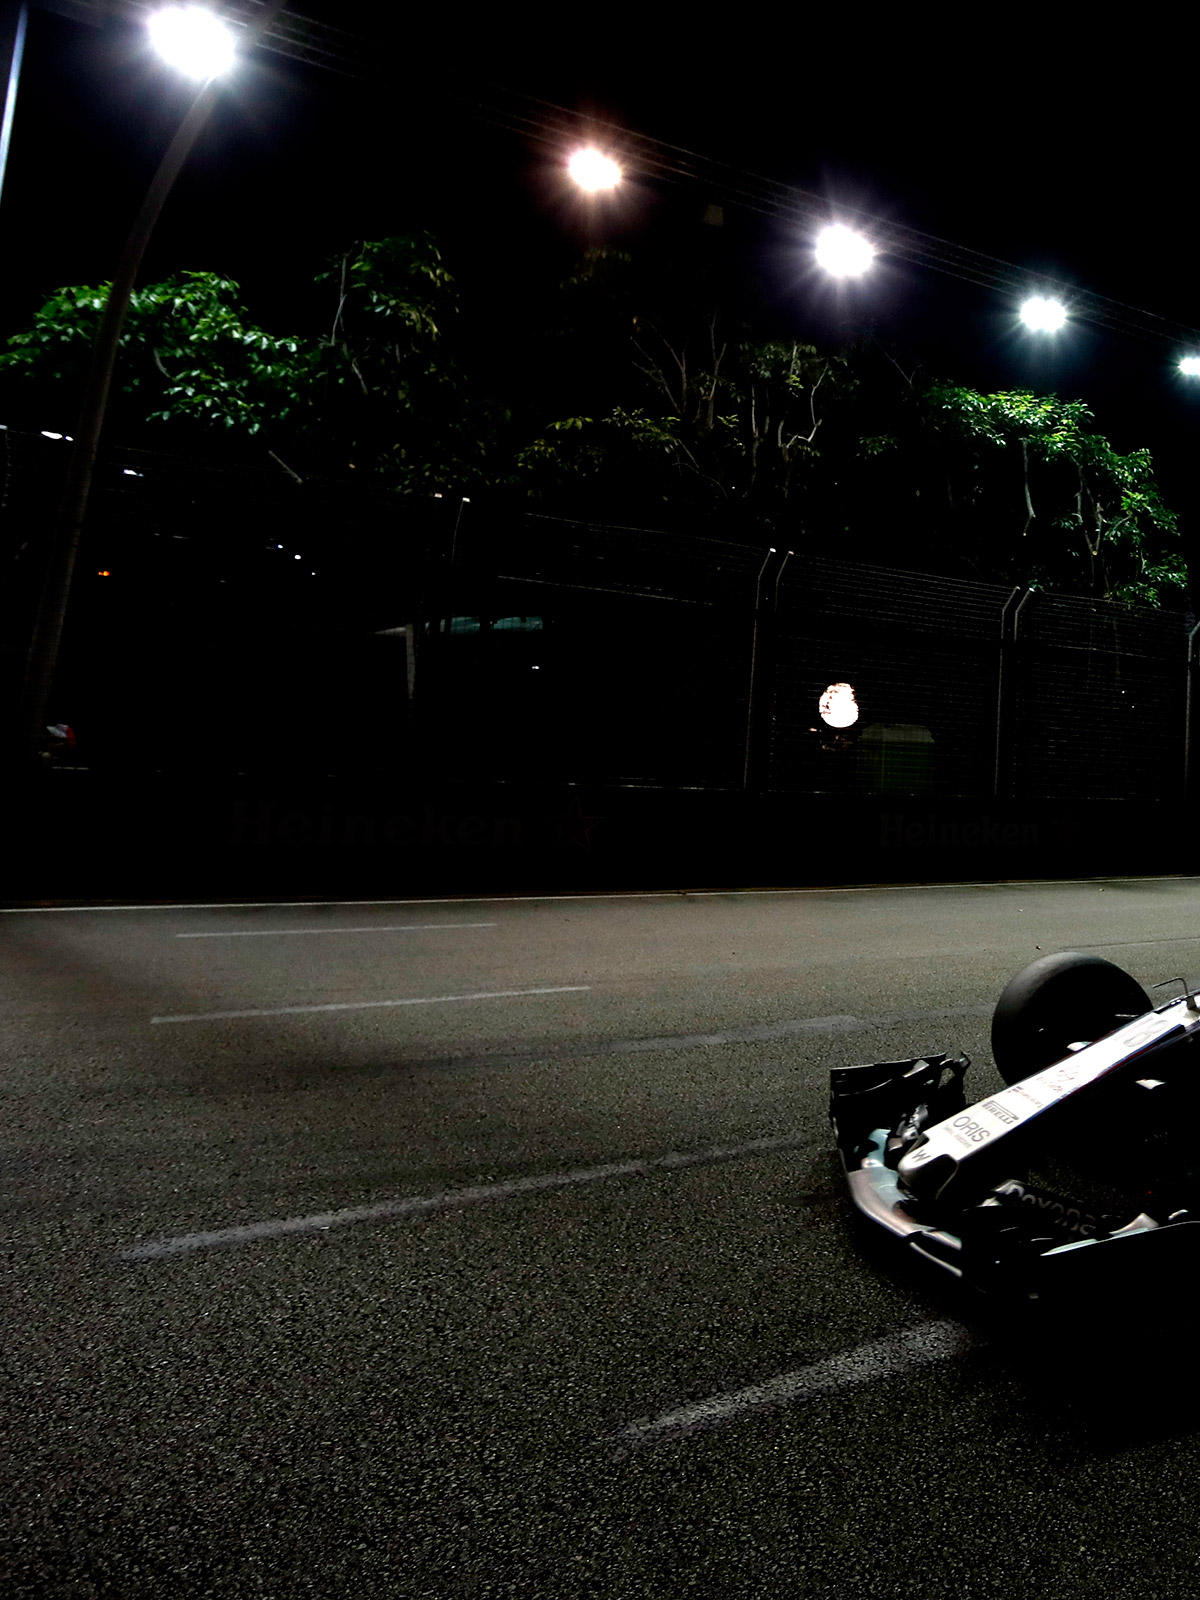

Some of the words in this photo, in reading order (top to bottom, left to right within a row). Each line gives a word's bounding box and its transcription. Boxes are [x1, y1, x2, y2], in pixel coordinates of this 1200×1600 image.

[227, 800, 525, 846] Heineken
[879, 812, 1040, 848] Heineken
[981, 1100, 1019, 1125] PIRELLI
[953, 1116, 991, 1143] ORIS
